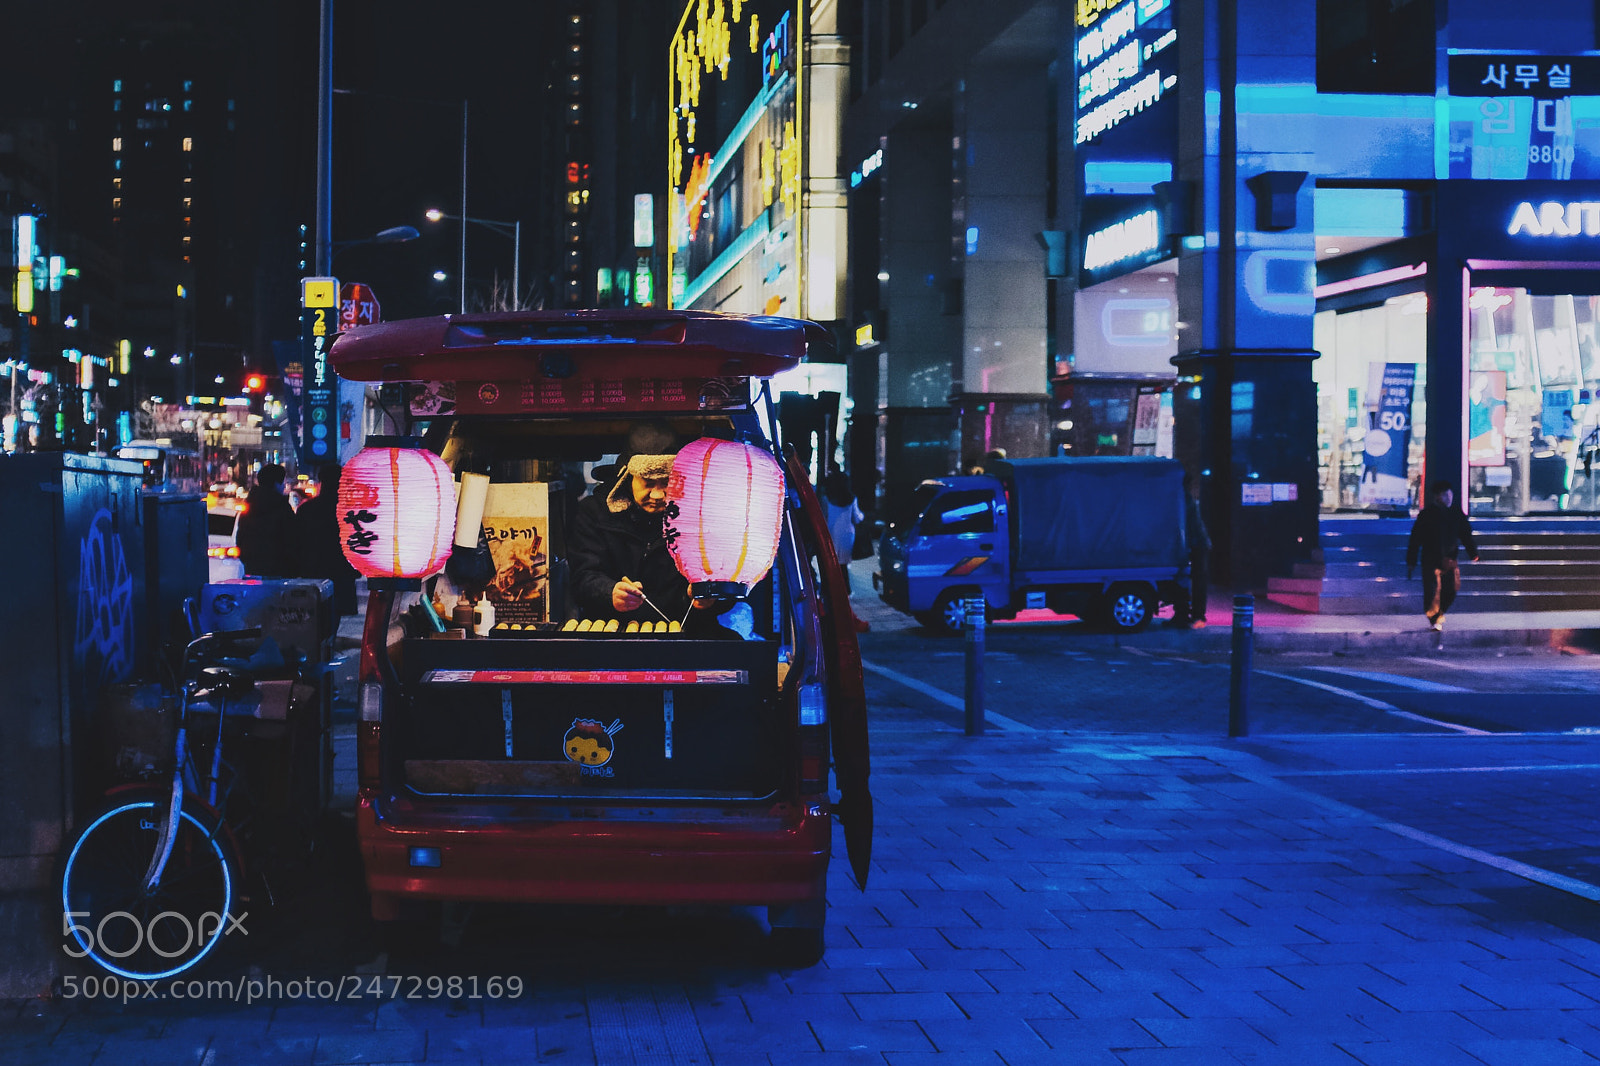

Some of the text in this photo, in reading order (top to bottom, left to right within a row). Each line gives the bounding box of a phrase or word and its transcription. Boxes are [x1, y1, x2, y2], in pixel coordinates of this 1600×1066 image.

[1481, 63, 1572, 89] 사무실
[1480, 98, 1573, 136] 임대
[341, 299, 373, 324] 정지
